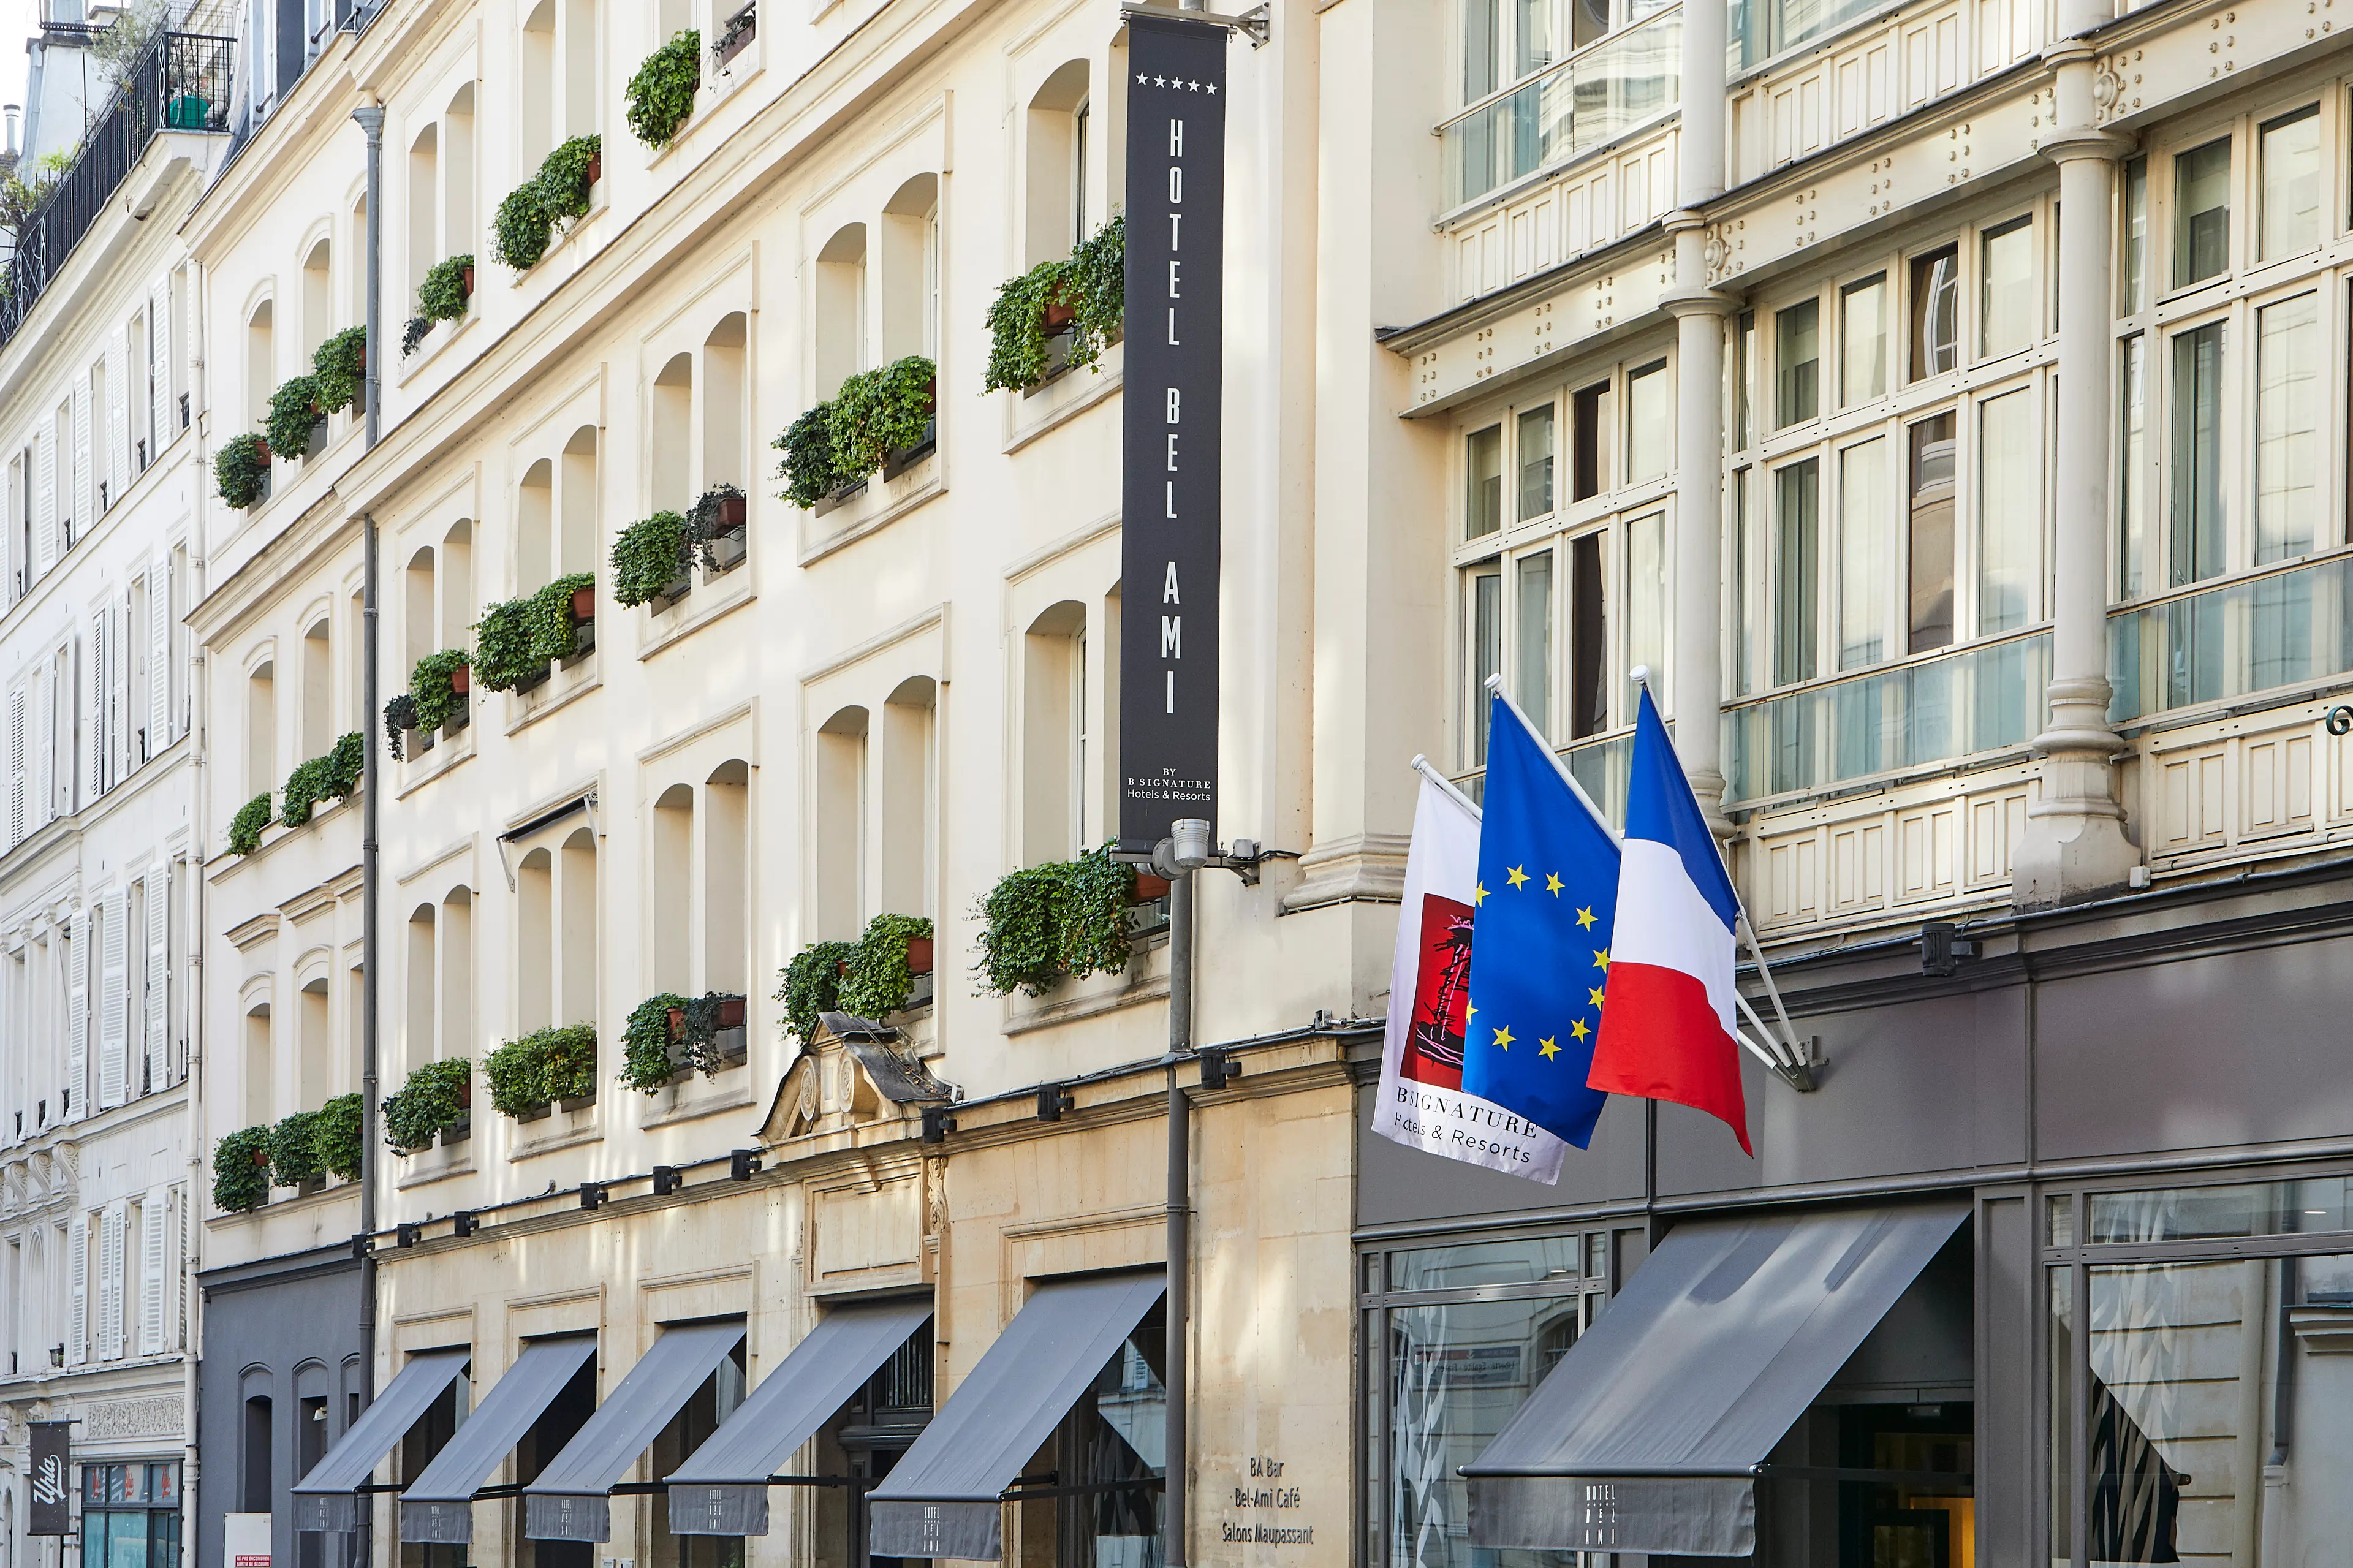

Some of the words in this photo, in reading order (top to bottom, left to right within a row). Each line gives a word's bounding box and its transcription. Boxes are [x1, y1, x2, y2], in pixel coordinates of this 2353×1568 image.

[1169, 119, 1183, 345] HOTEL
[1167, 388, 1180, 518] BEL
[1161, 561, 1181, 714] AMI
[1162, 768, 1176, 776] BY
[1139, 778, 1211, 789] SIGNATURE
[1127, 789, 1159, 798] Hotels
[1162, 790, 1170, 800] &
[1173, 791, 1210, 801] Resorts
[1431, 1125, 1442, 1140] &
[1451, 1129, 1531, 1163] Resorts
[1250, 1456, 1264, 1477] BA
[1267, 1457, 1284, 1477] Bar
[1235, 1487, 1273, 1508] Bel-Ami
[1276, 1487, 1300, 1508] Café
[1586, 1485, 1615, 1501] HOTEL
[1222, 1522, 1252, 1542] Salons
[1254, 1523, 1314, 1549] Maupassant
[1585, 1529, 1615, 1545] AMI
